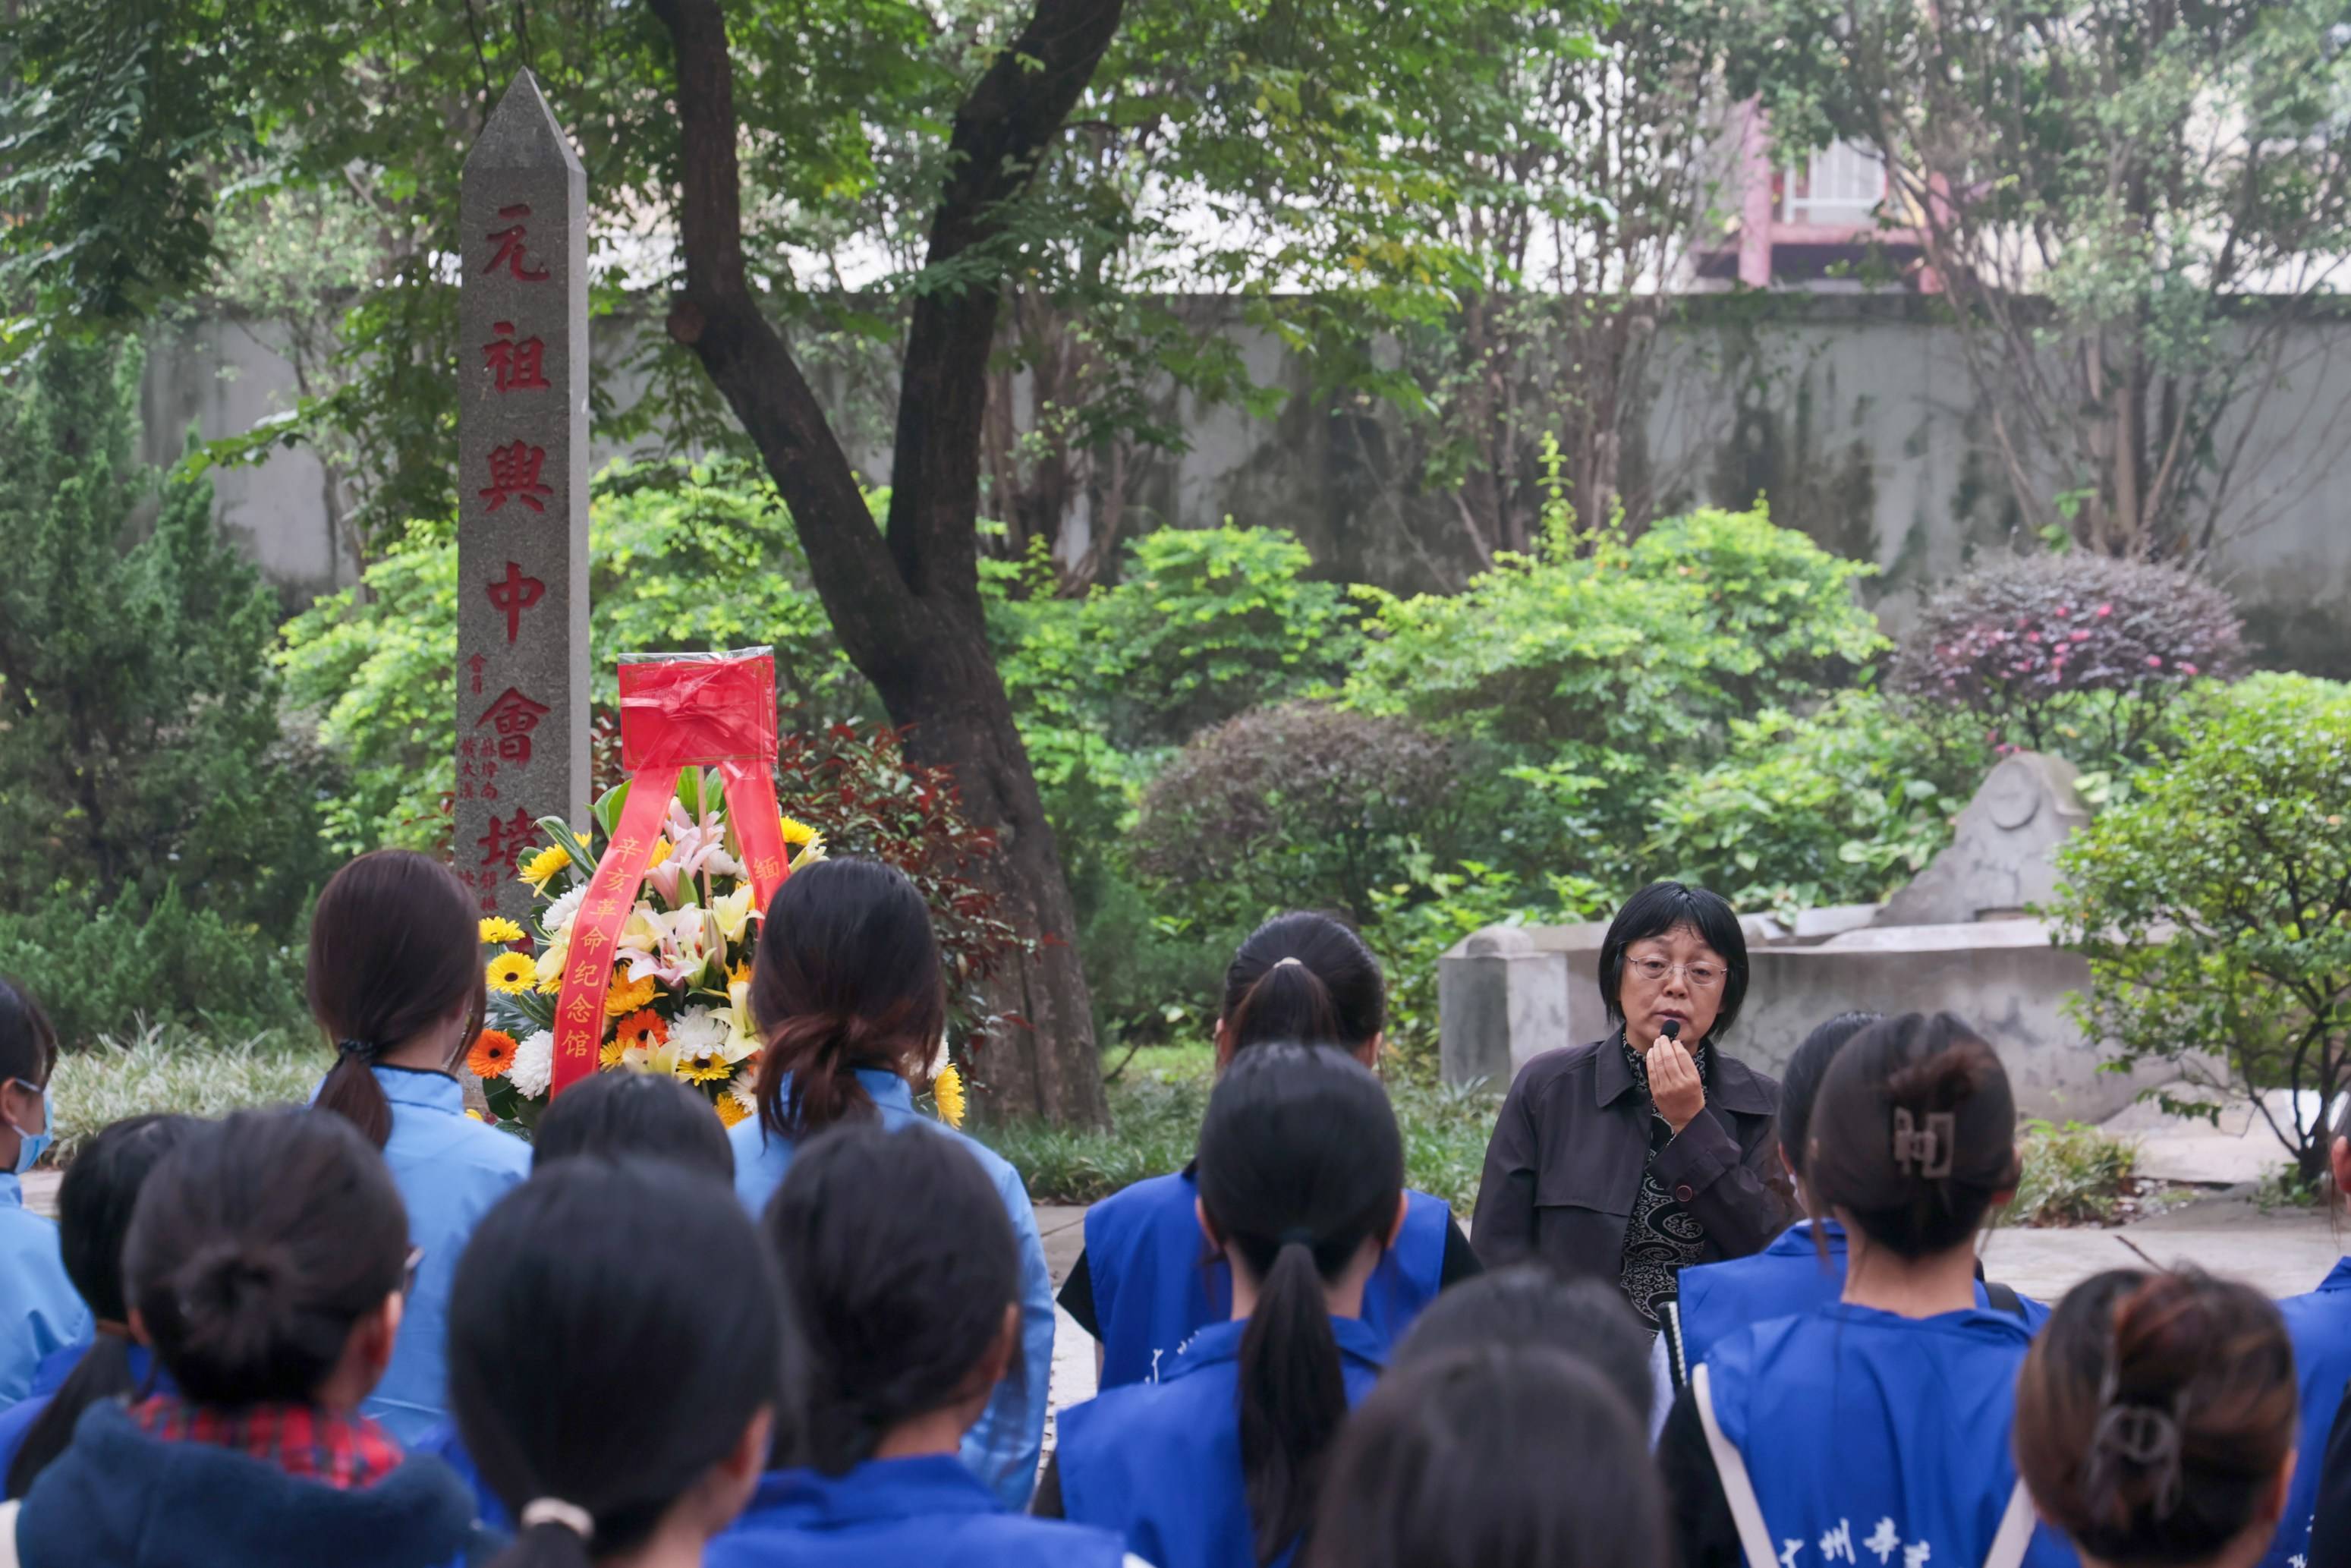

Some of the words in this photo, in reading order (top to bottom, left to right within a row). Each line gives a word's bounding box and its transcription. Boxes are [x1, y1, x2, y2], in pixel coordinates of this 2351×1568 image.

[475, 203, 554, 956] 元祖興中會墳
[562, 836, 644, 1059] 辛亥革命纪念馆
